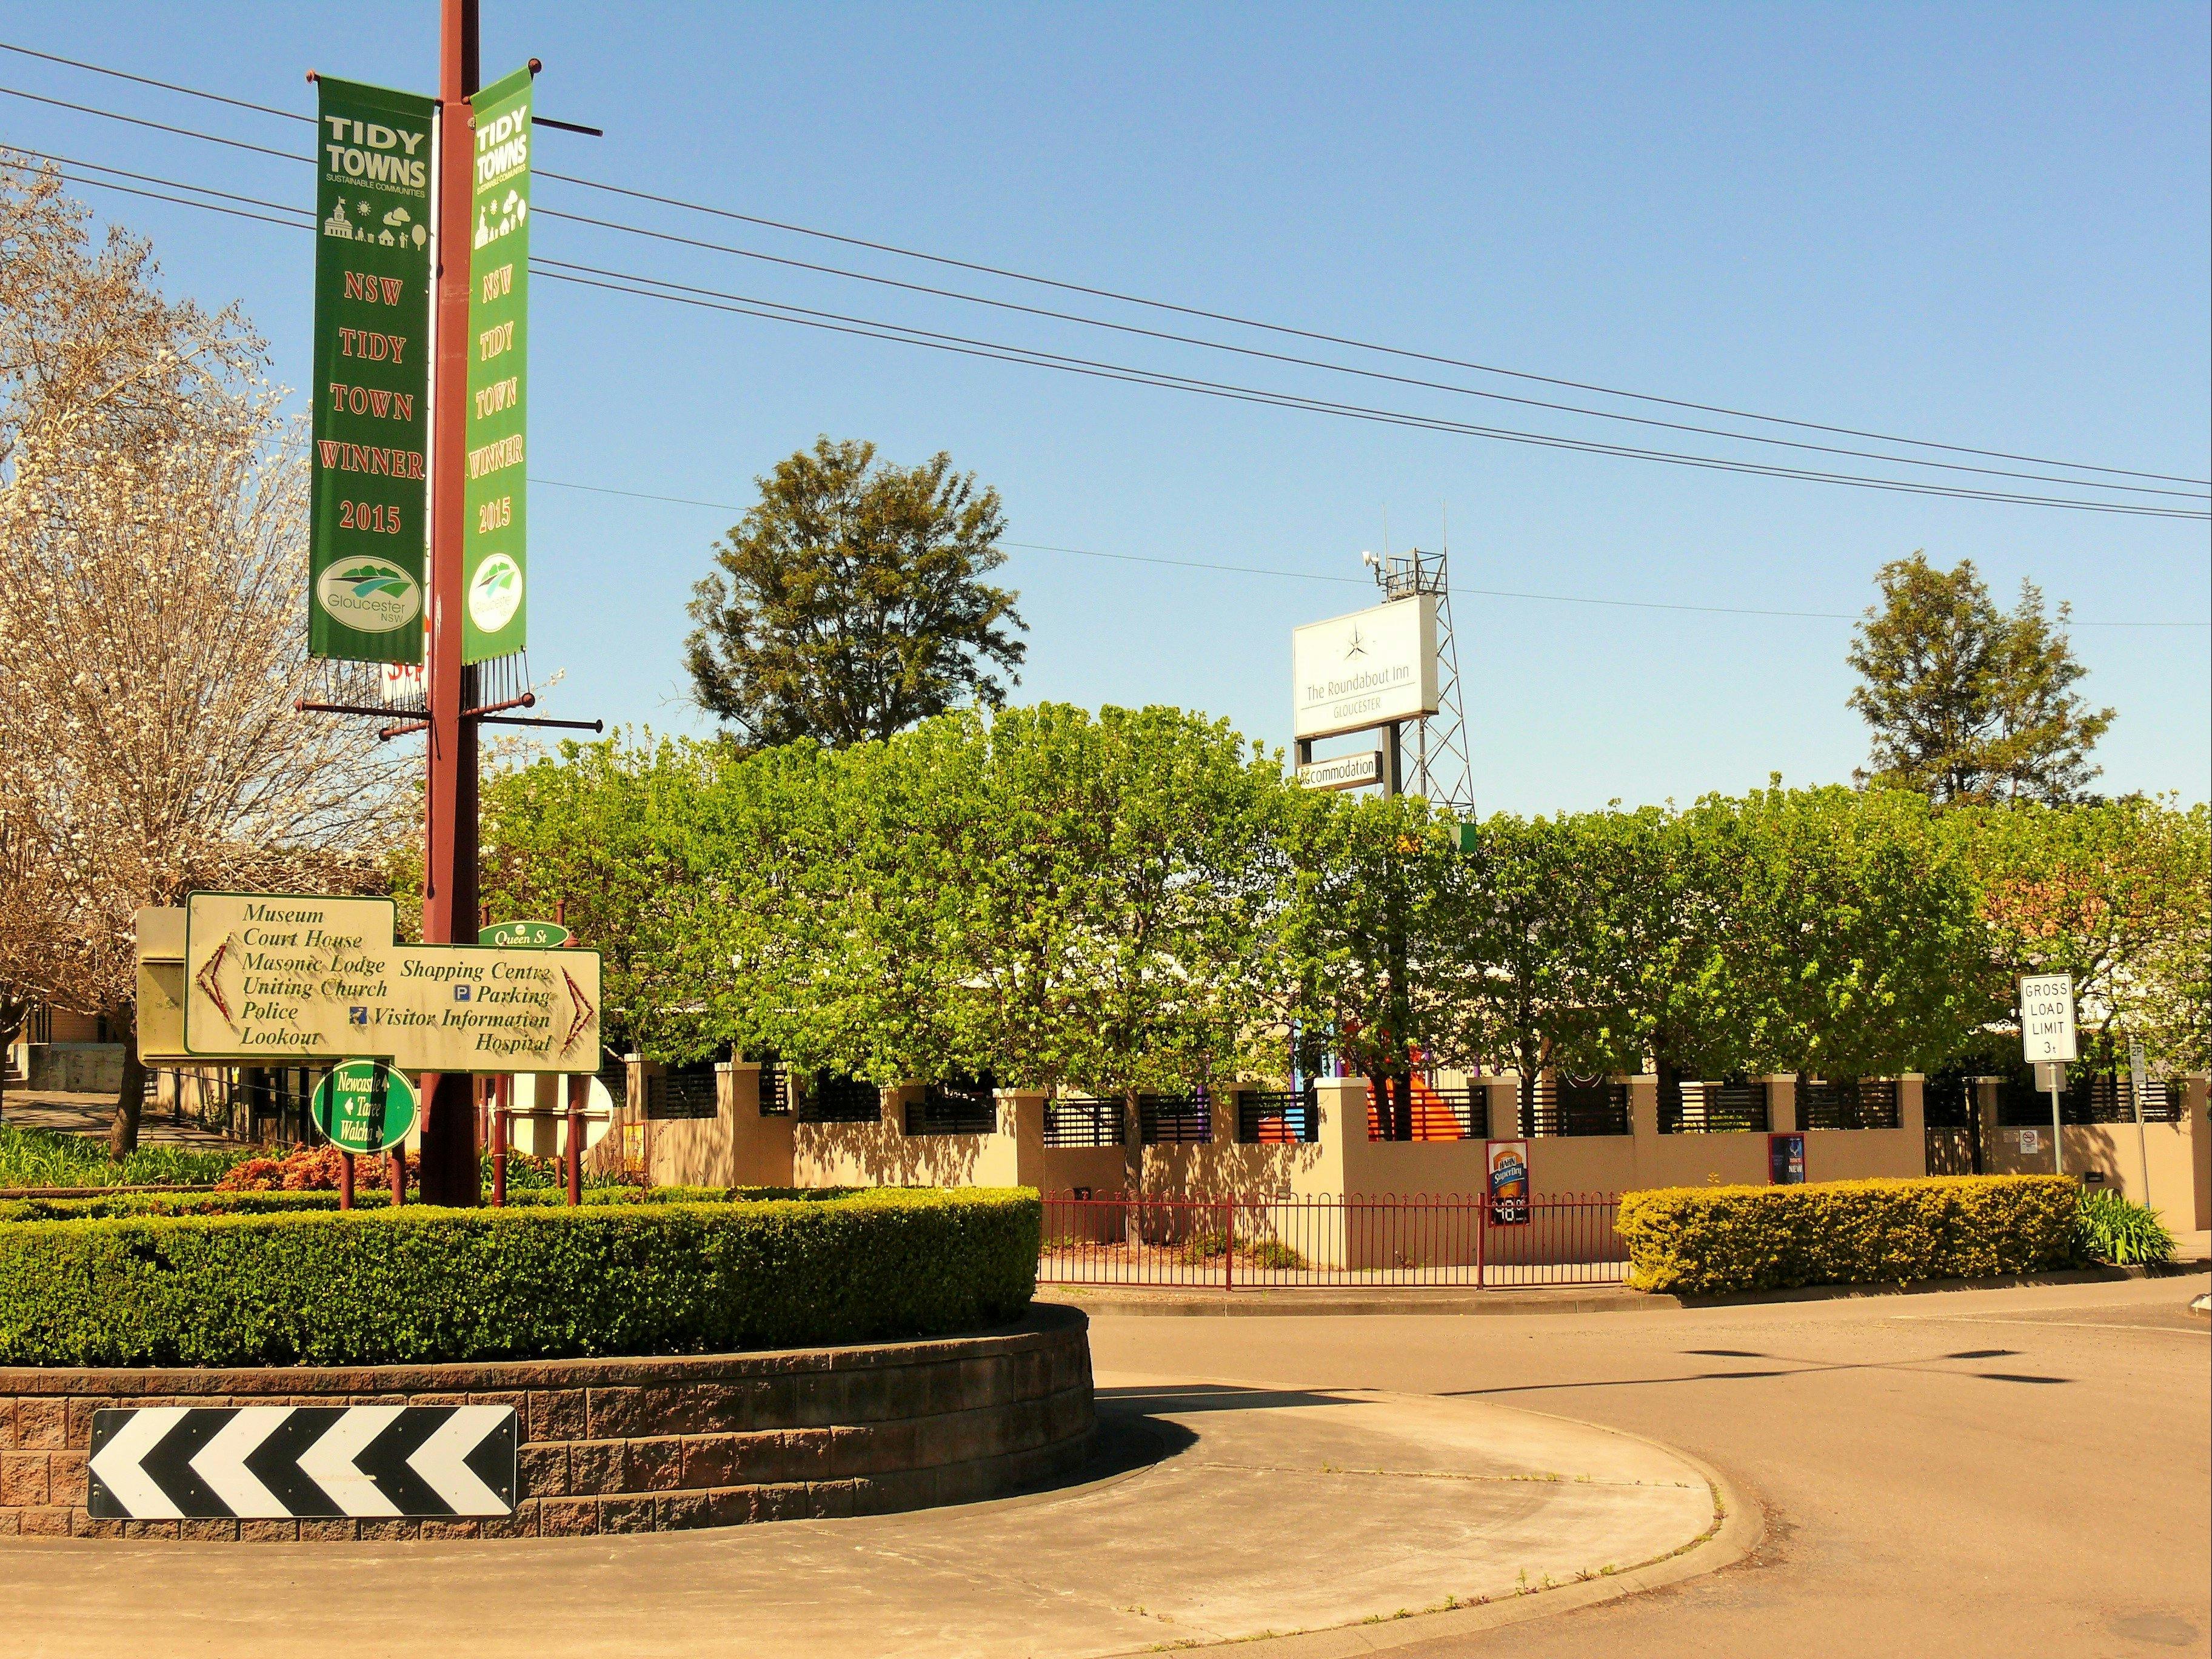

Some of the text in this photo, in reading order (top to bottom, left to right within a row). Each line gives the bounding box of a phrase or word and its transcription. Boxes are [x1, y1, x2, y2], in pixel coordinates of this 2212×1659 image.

[325, 115, 424, 155] TIDY
[476, 105, 527, 152] TIDY
[326, 144, 426, 188] TOWNS
[476, 134, 527, 184] TOWNS
[326, 173, 425, 198] SUSTAINABLE COMMUNITIES
[344, 271, 403, 306] NSW
[483, 264, 513, 304] NSW
[339, 327, 406, 364] TIDY
[480, 320, 514, 361] TIDY
[330, 383, 413, 421] TOWN
[476, 377, 518, 420] TOWN
[317, 440, 425, 480] WINNER
[469, 434, 524, 480] WINNER
[339, 500, 401, 534] 2015
[479, 496, 510, 534] 2015
[327, 594, 406, 614] Gloucester
[381, 612, 403, 623] NSW
[1308, 666, 1409, 700] The Roundabout Inn
[1334, 697, 1381, 719] GLOUCESTER
[242, 903, 324, 923] Museum
[243, 928, 363, 948] Court House
[495, 930, 547, 947] Queen St
[242, 953, 385, 977] Masonic Lodge
[400, 959, 550, 982] Shopping Centre
[243, 976, 387, 999] Uniting Church
[476, 985, 552, 1007] Parking
[2026, 983, 2067, 997] GROSS
[241, 1001, 298, 1019] Police
[375, 1007, 550, 1030] Visitor Information
[2031, 1002, 2063, 1016] LOAD
[240, 1027, 321, 1045] Lookout
[2033, 1022, 2063, 1034] LIMIT
[475, 1033, 552, 1054] Hospital
[2131, 1047, 2142, 1056] 2P
[337, 1071, 380, 1093] Newcastle
[357, 1096, 380, 1117] Taree
[341, 1120, 372, 1141] Walcha
